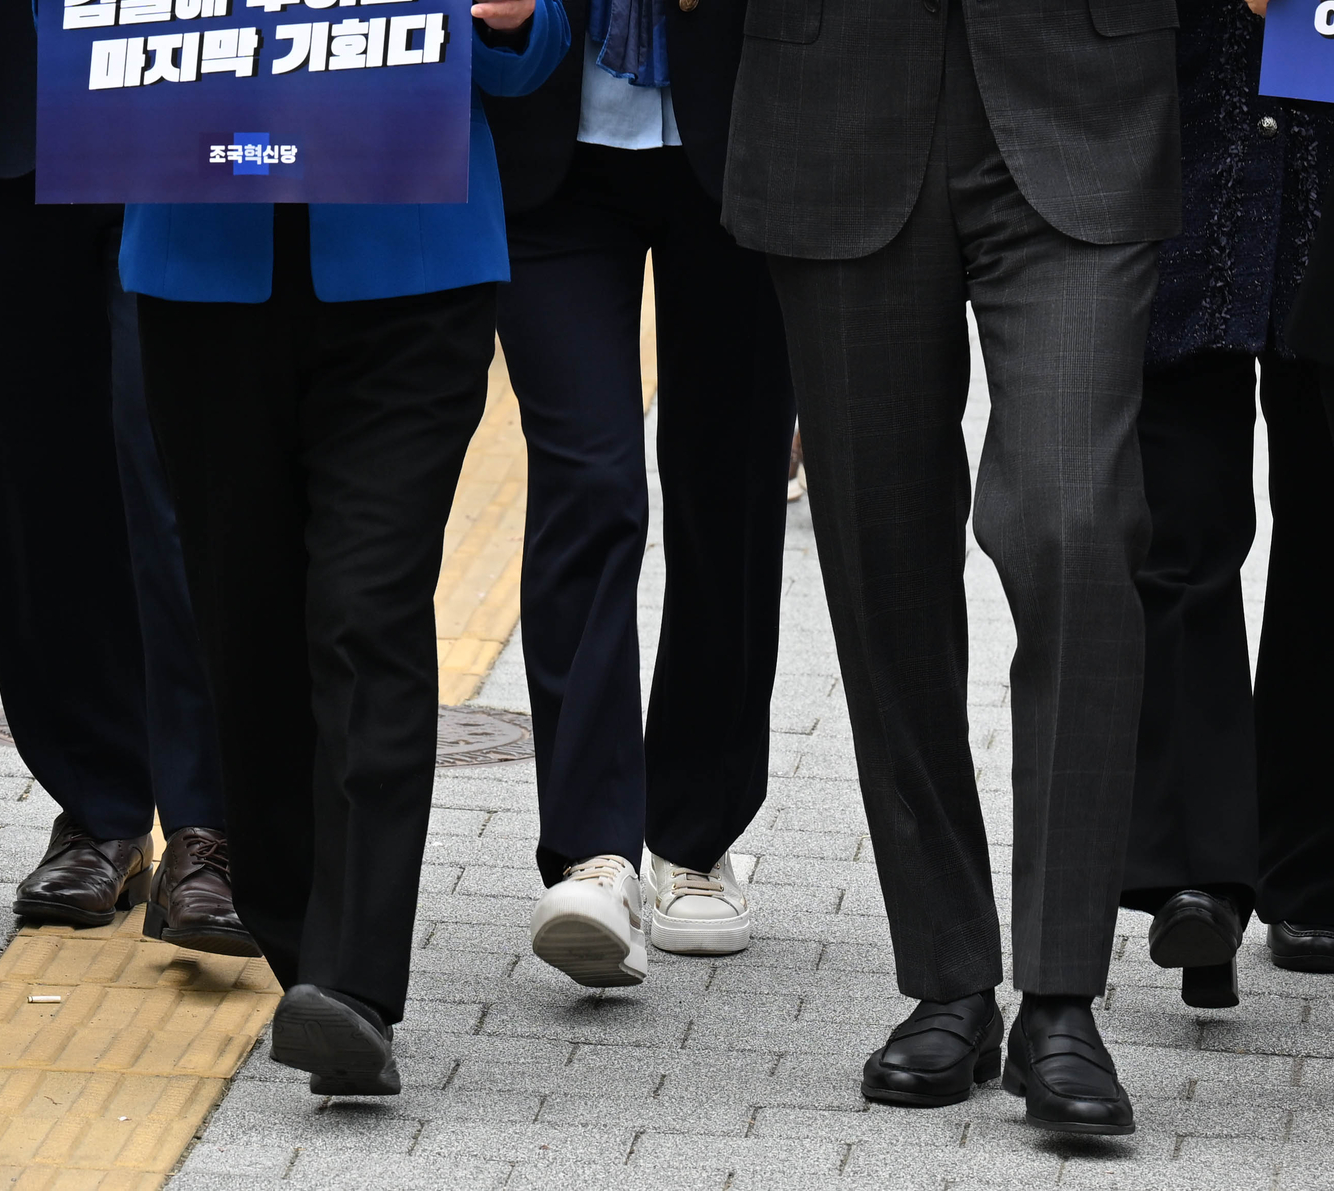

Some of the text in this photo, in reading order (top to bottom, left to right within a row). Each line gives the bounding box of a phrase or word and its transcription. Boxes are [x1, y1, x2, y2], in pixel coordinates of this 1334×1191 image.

[88, 12, 445, 91] 마지막 기회다
[210, 144, 297, 164] 조국혁신당
